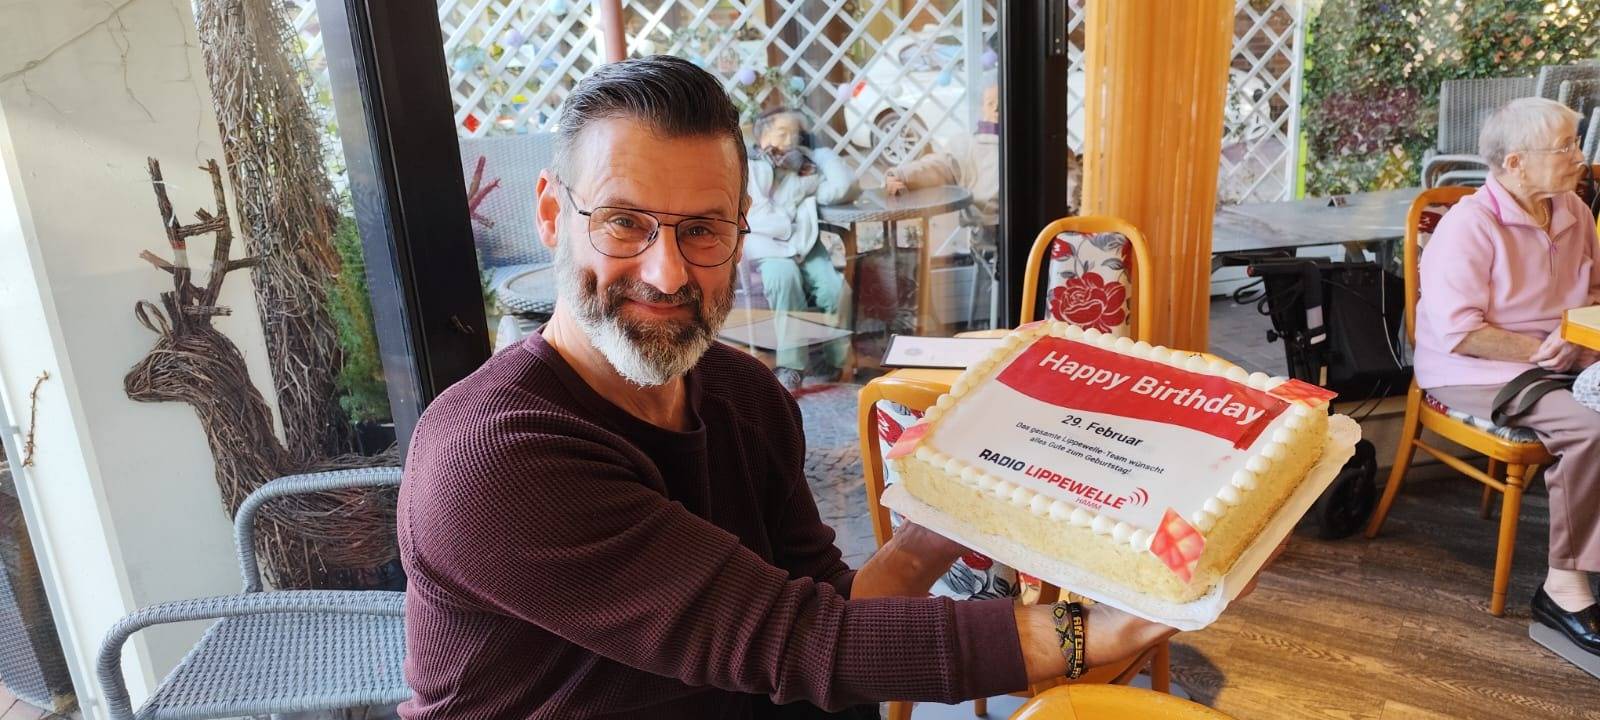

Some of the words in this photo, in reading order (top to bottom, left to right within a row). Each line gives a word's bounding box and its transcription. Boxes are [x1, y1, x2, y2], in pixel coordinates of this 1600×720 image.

[1039, 351, 1130, 391] Happy
[1131, 375, 1266, 425] Birthday
[1016, 422, 1031, 430] Das
[1030, 427, 1061, 440] gesamte
[1062, 436, 1127, 463] Lippewelle-Team
[1129, 458, 1165, 474] wünscht
[1061, 415, 1082, 428] 29.
[1086, 422, 1143, 446] Februar
[1030, 437, 1047, 446] alles
[1048, 442, 1066, 451] Gute
[1066, 448, 1084, 458] zum
[1085, 454, 1132, 475] Geburtstag!
[979, 449, 1026, 471] RADIO
[1025, 465, 1127, 509] LIPPEWELLE
[1076, 498, 1102, 510] HAMM
